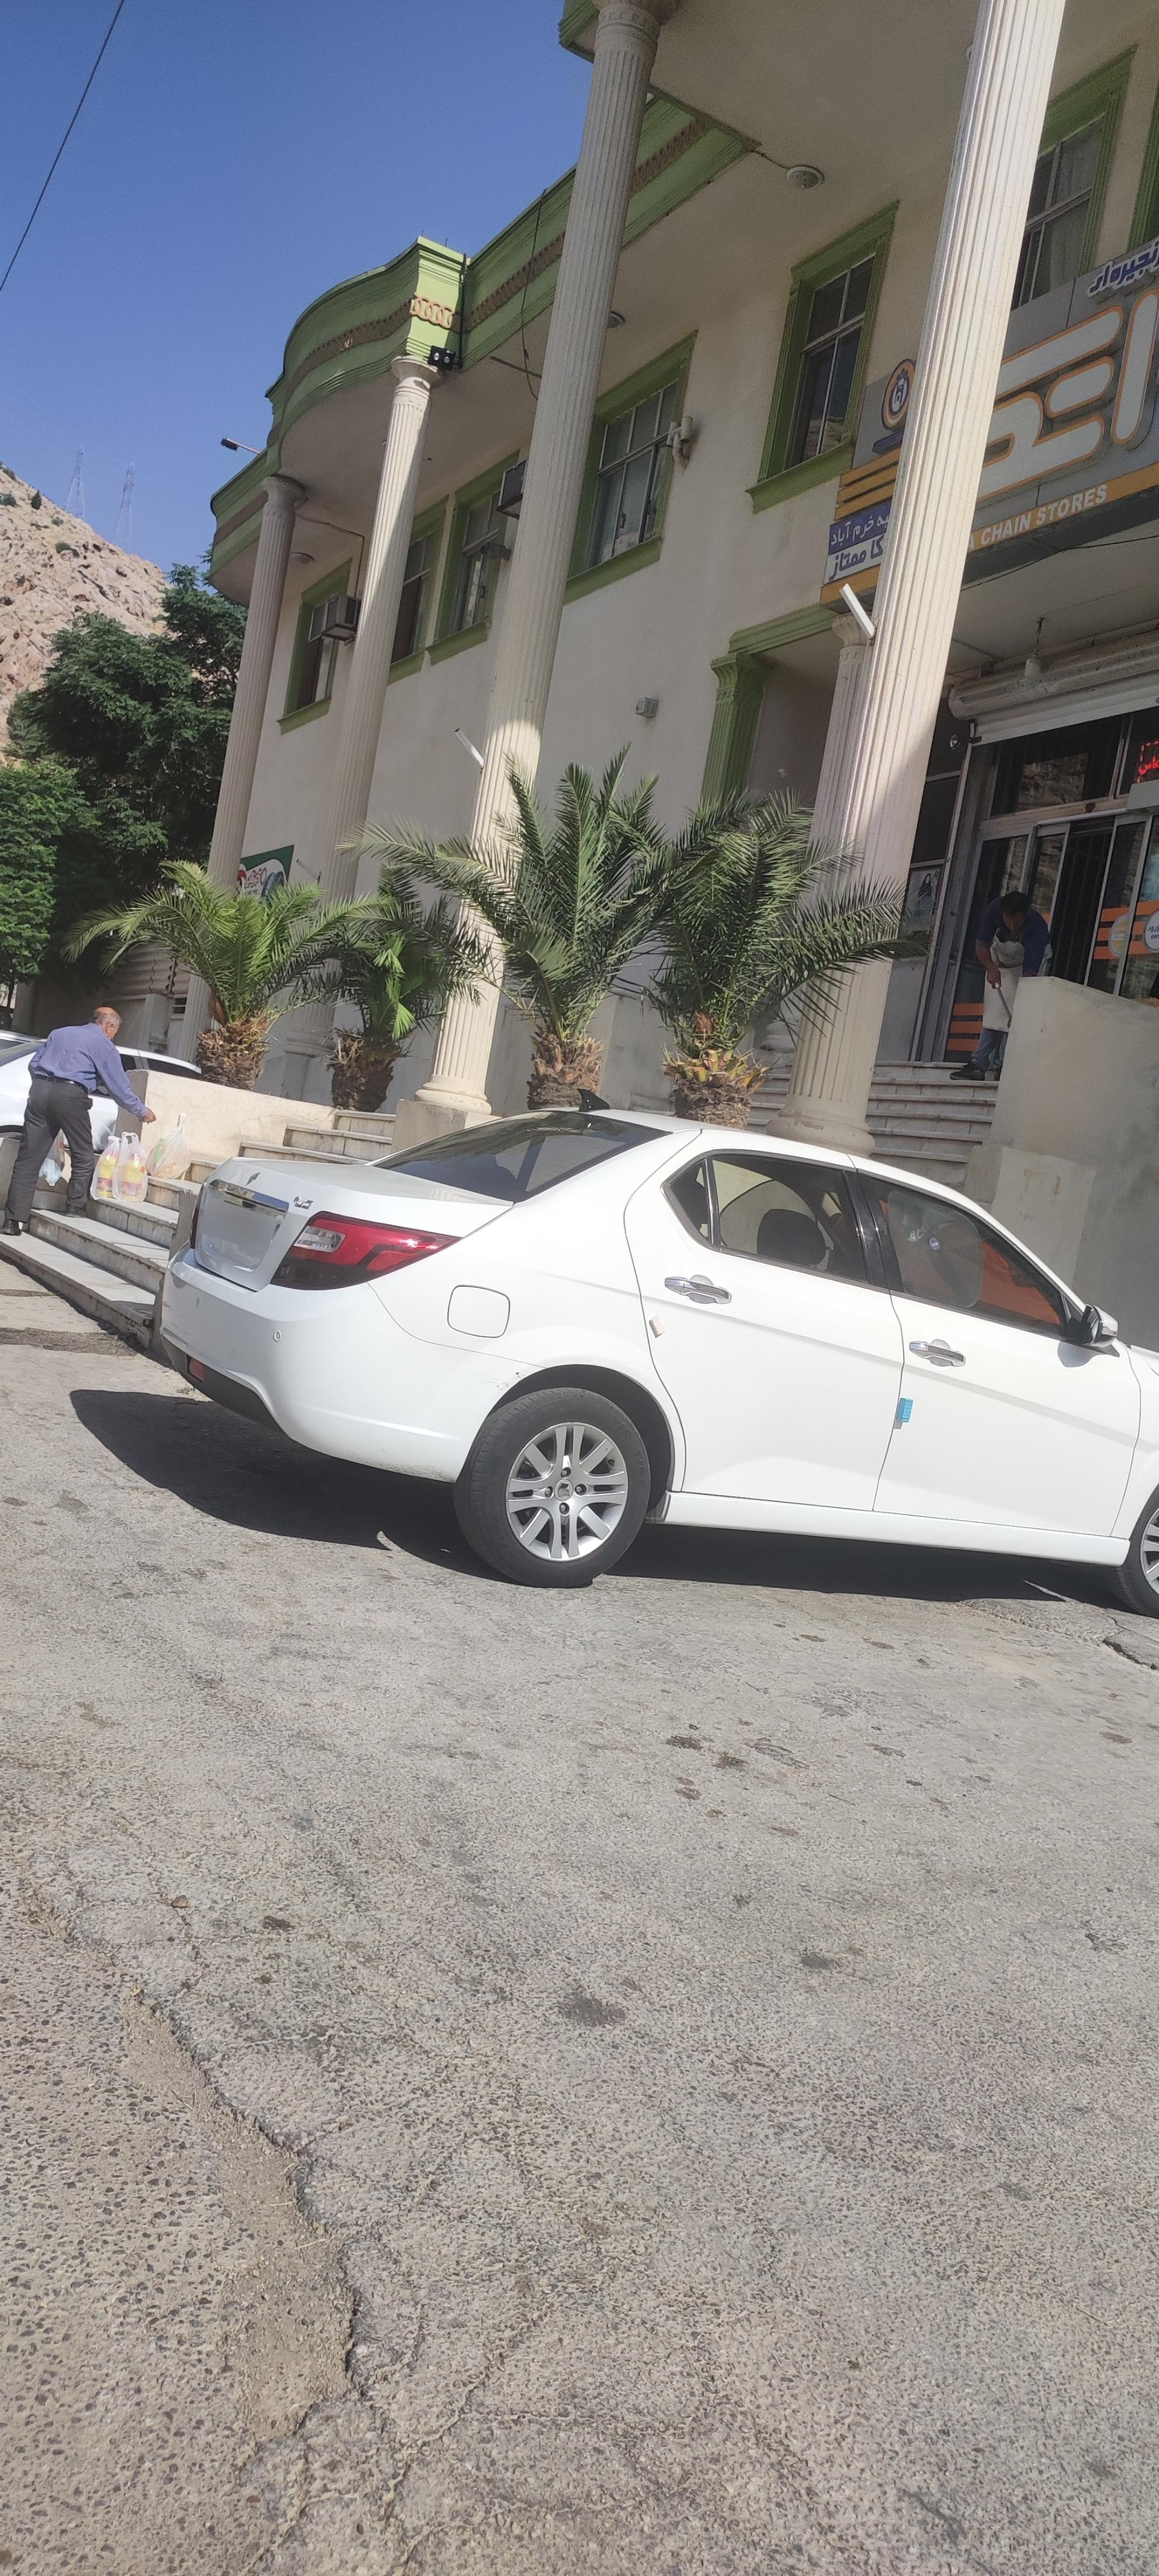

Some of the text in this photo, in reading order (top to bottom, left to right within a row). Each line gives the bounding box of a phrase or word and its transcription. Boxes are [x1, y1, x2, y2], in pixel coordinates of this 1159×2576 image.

[852, 516, 874, 542] خرم
[981, 512, 1032, 545] CHAIN
[1035, 484, 1108, 525] STORES
[831, 521, 852, 546] آباد
[828, 534, 884, 582] کا ممتاز
